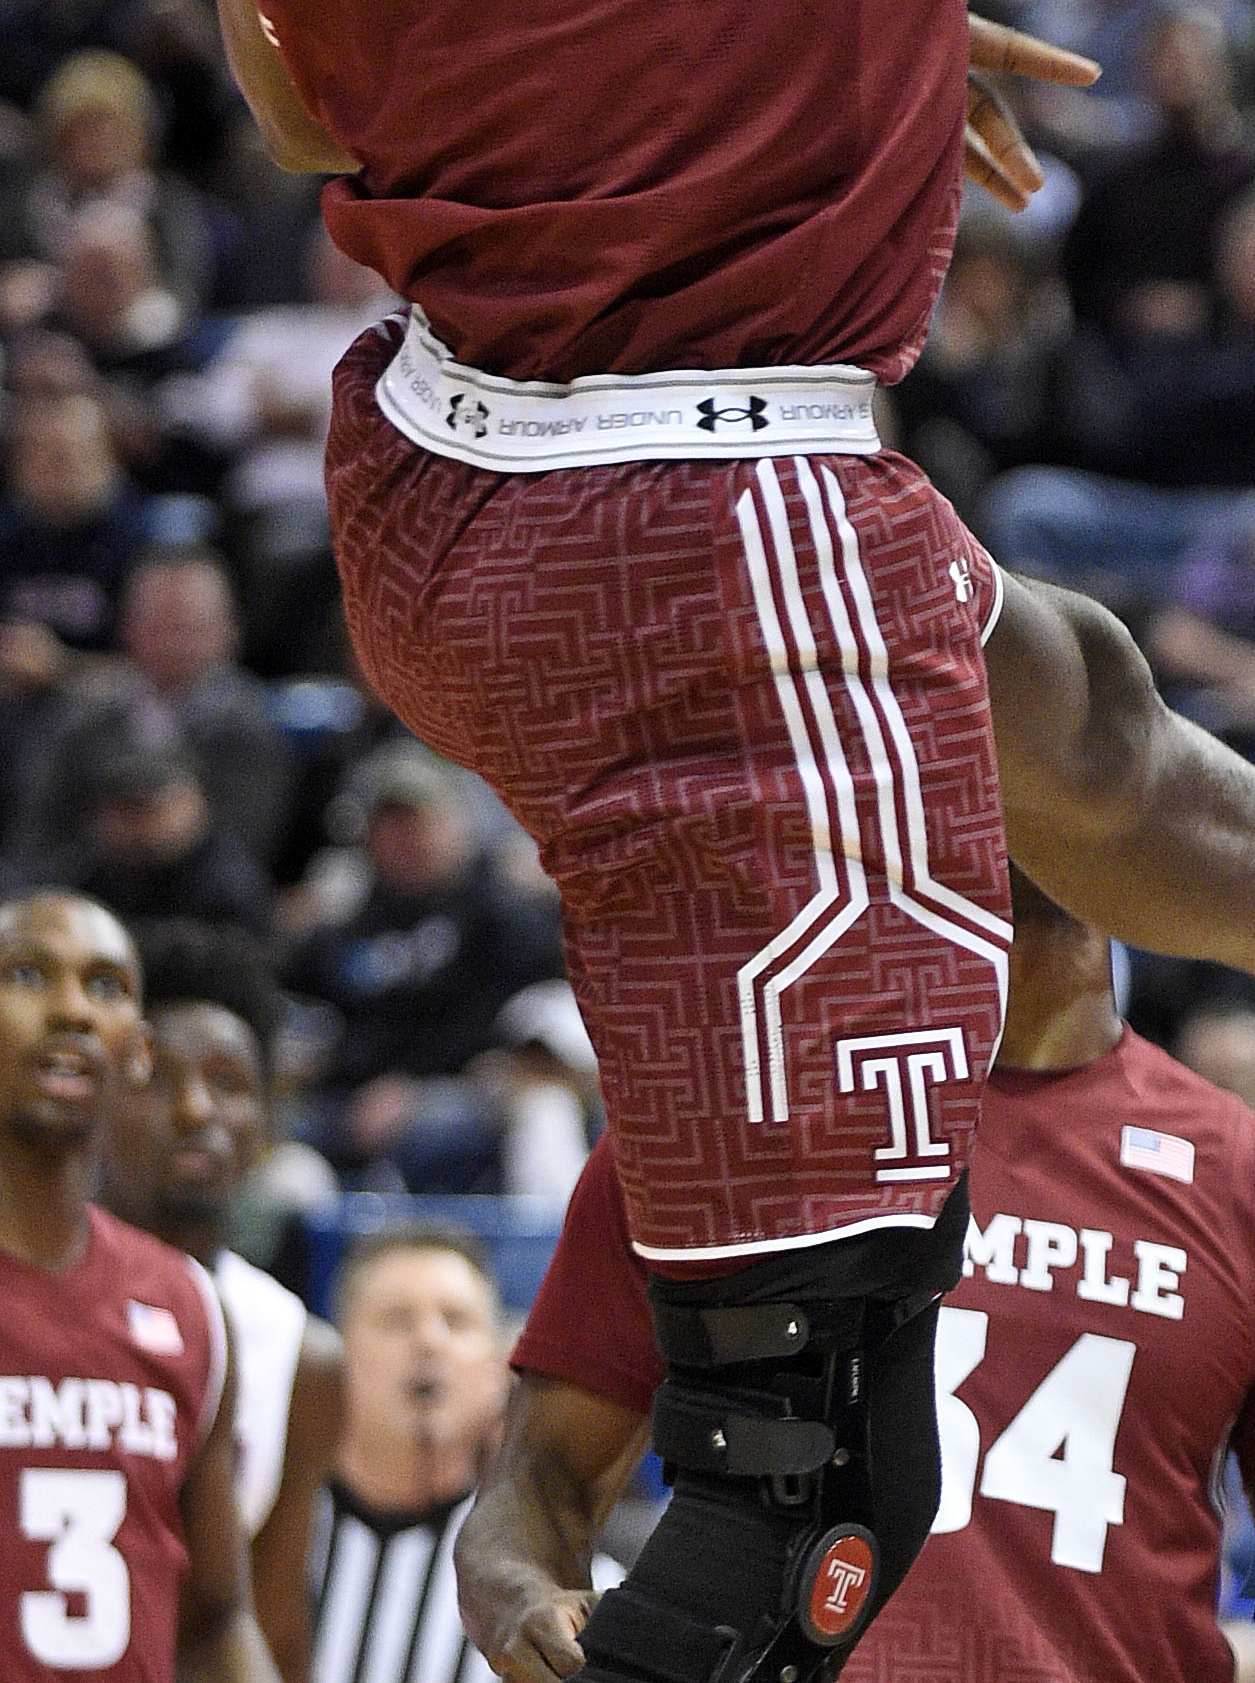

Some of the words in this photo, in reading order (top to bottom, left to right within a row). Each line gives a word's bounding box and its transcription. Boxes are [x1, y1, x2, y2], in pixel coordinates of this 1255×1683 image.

[499, 417, 588, 437] ARMOUR
[598, 410, 683, 430] UNDER
[837, 1027, 969, 1182] T
[962, 1213, 1188, 1321] MPLE
[0, 1374, 179, 1462] EMPLE
[19, 1467, 131, 1669] 3
